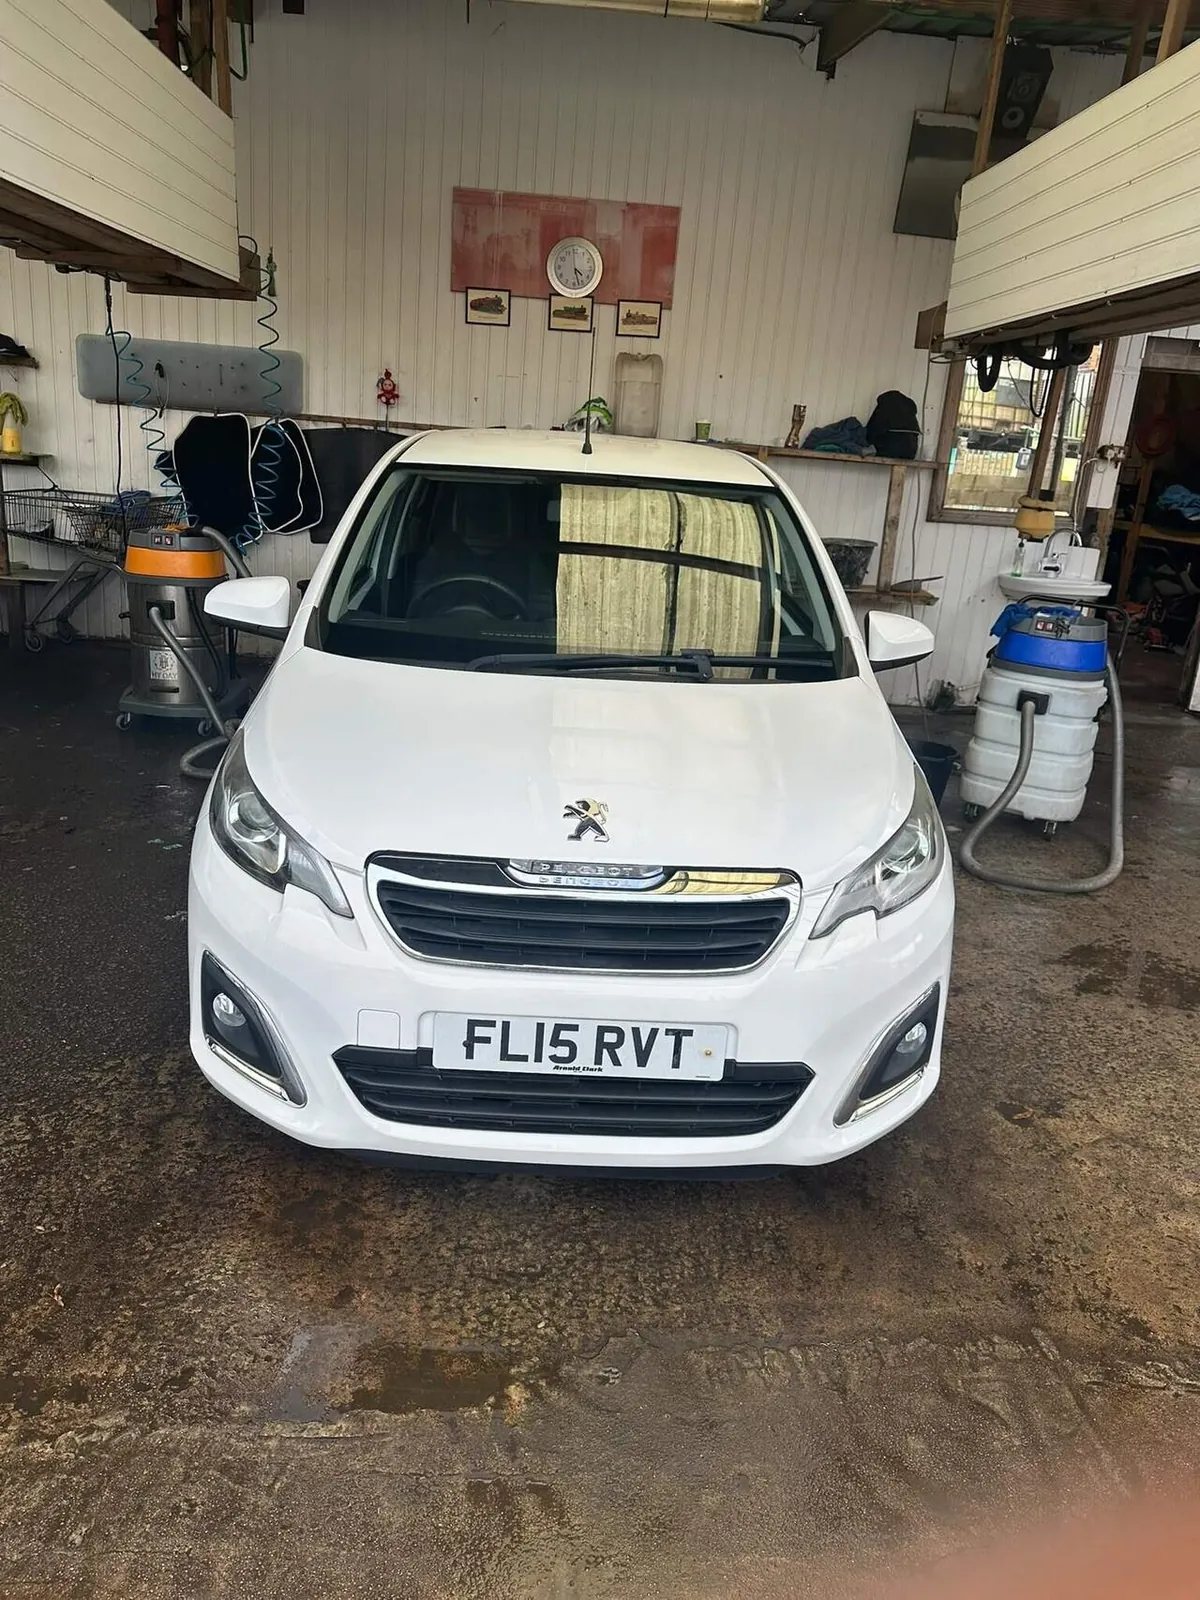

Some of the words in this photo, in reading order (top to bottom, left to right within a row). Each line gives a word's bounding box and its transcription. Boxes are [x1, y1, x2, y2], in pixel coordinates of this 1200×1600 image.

[540, 862, 633, 876] PEUGEOT
[465, 1019, 580, 1065] FL15
[593, 1025, 694, 1069] RVT
